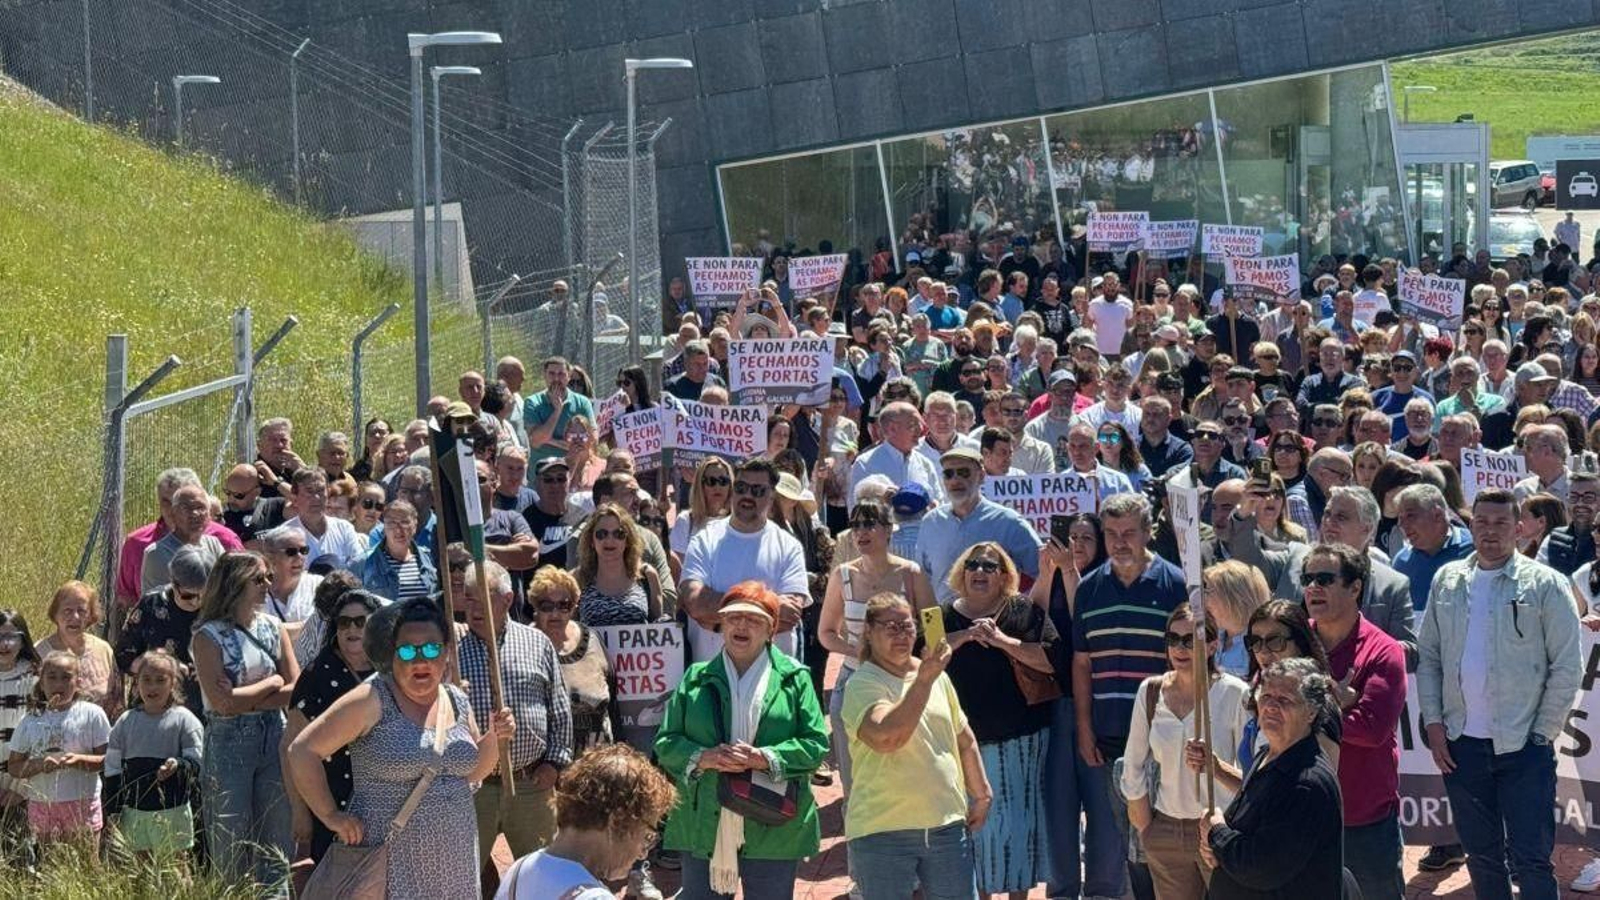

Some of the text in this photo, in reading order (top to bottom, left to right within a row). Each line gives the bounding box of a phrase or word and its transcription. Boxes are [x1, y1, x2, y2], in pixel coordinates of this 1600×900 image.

[1100, 213, 1119, 221] NON
[1092, 222, 1140, 230] PECHAMOS
[1204, 226, 1214, 234] SE
[1218, 227, 1237, 235] NON
[1092, 231, 1140, 240] AS PORTAS
[1210, 234, 1257, 246] PECHAMOS
[686, 260, 699, 270] SE
[704, 260, 727, 270] NON
[789, 259, 798, 269] SE
[801, 258, 821, 267] NON
[694, 271, 754, 281] PECHAMOS
[797, 277, 807, 287] AS
[696, 282, 708, 292] AS
[730, 340, 832, 355] SE NON PARA,
[739, 355, 820, 369] PECHAMOS
[740, 370, 819, 385] AS PORTAS
[613, 416, 629, 430] SE
[633, 410, 657, 427] NON
[721, 408, 765, 424] PARA,
[677, 430, 754, 453] AS PORTAS
[1464, 452, 1518, 474] SE NON
[994, 476, 1092, 496] NON PARA,
[544, 526, 573, 541] NIKE
[619, 628, 680, 649] PARA,
